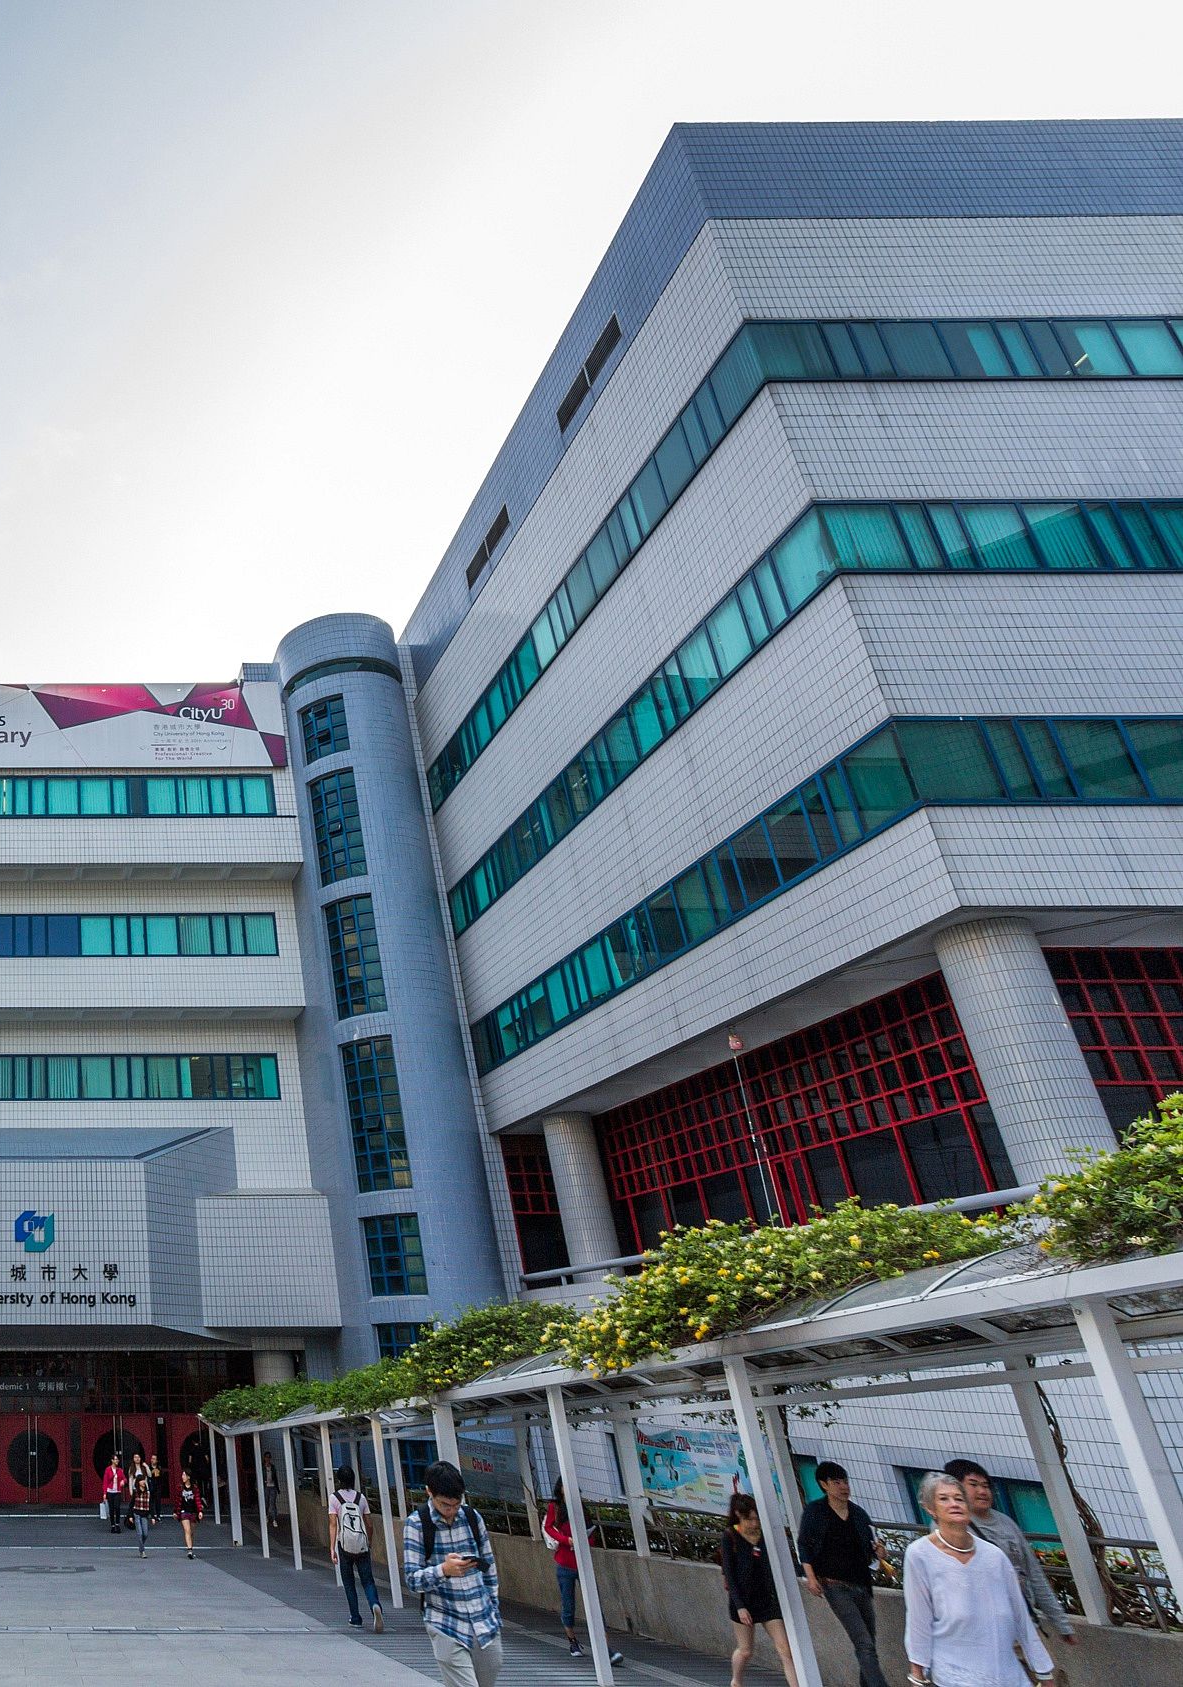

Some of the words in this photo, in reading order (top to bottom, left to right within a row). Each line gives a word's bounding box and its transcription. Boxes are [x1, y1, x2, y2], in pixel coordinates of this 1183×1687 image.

[40, 1291, 56, 1305] of
[60, 1291, 96, 1307] Hong
[102, 1291, 137, 1307] Kong
